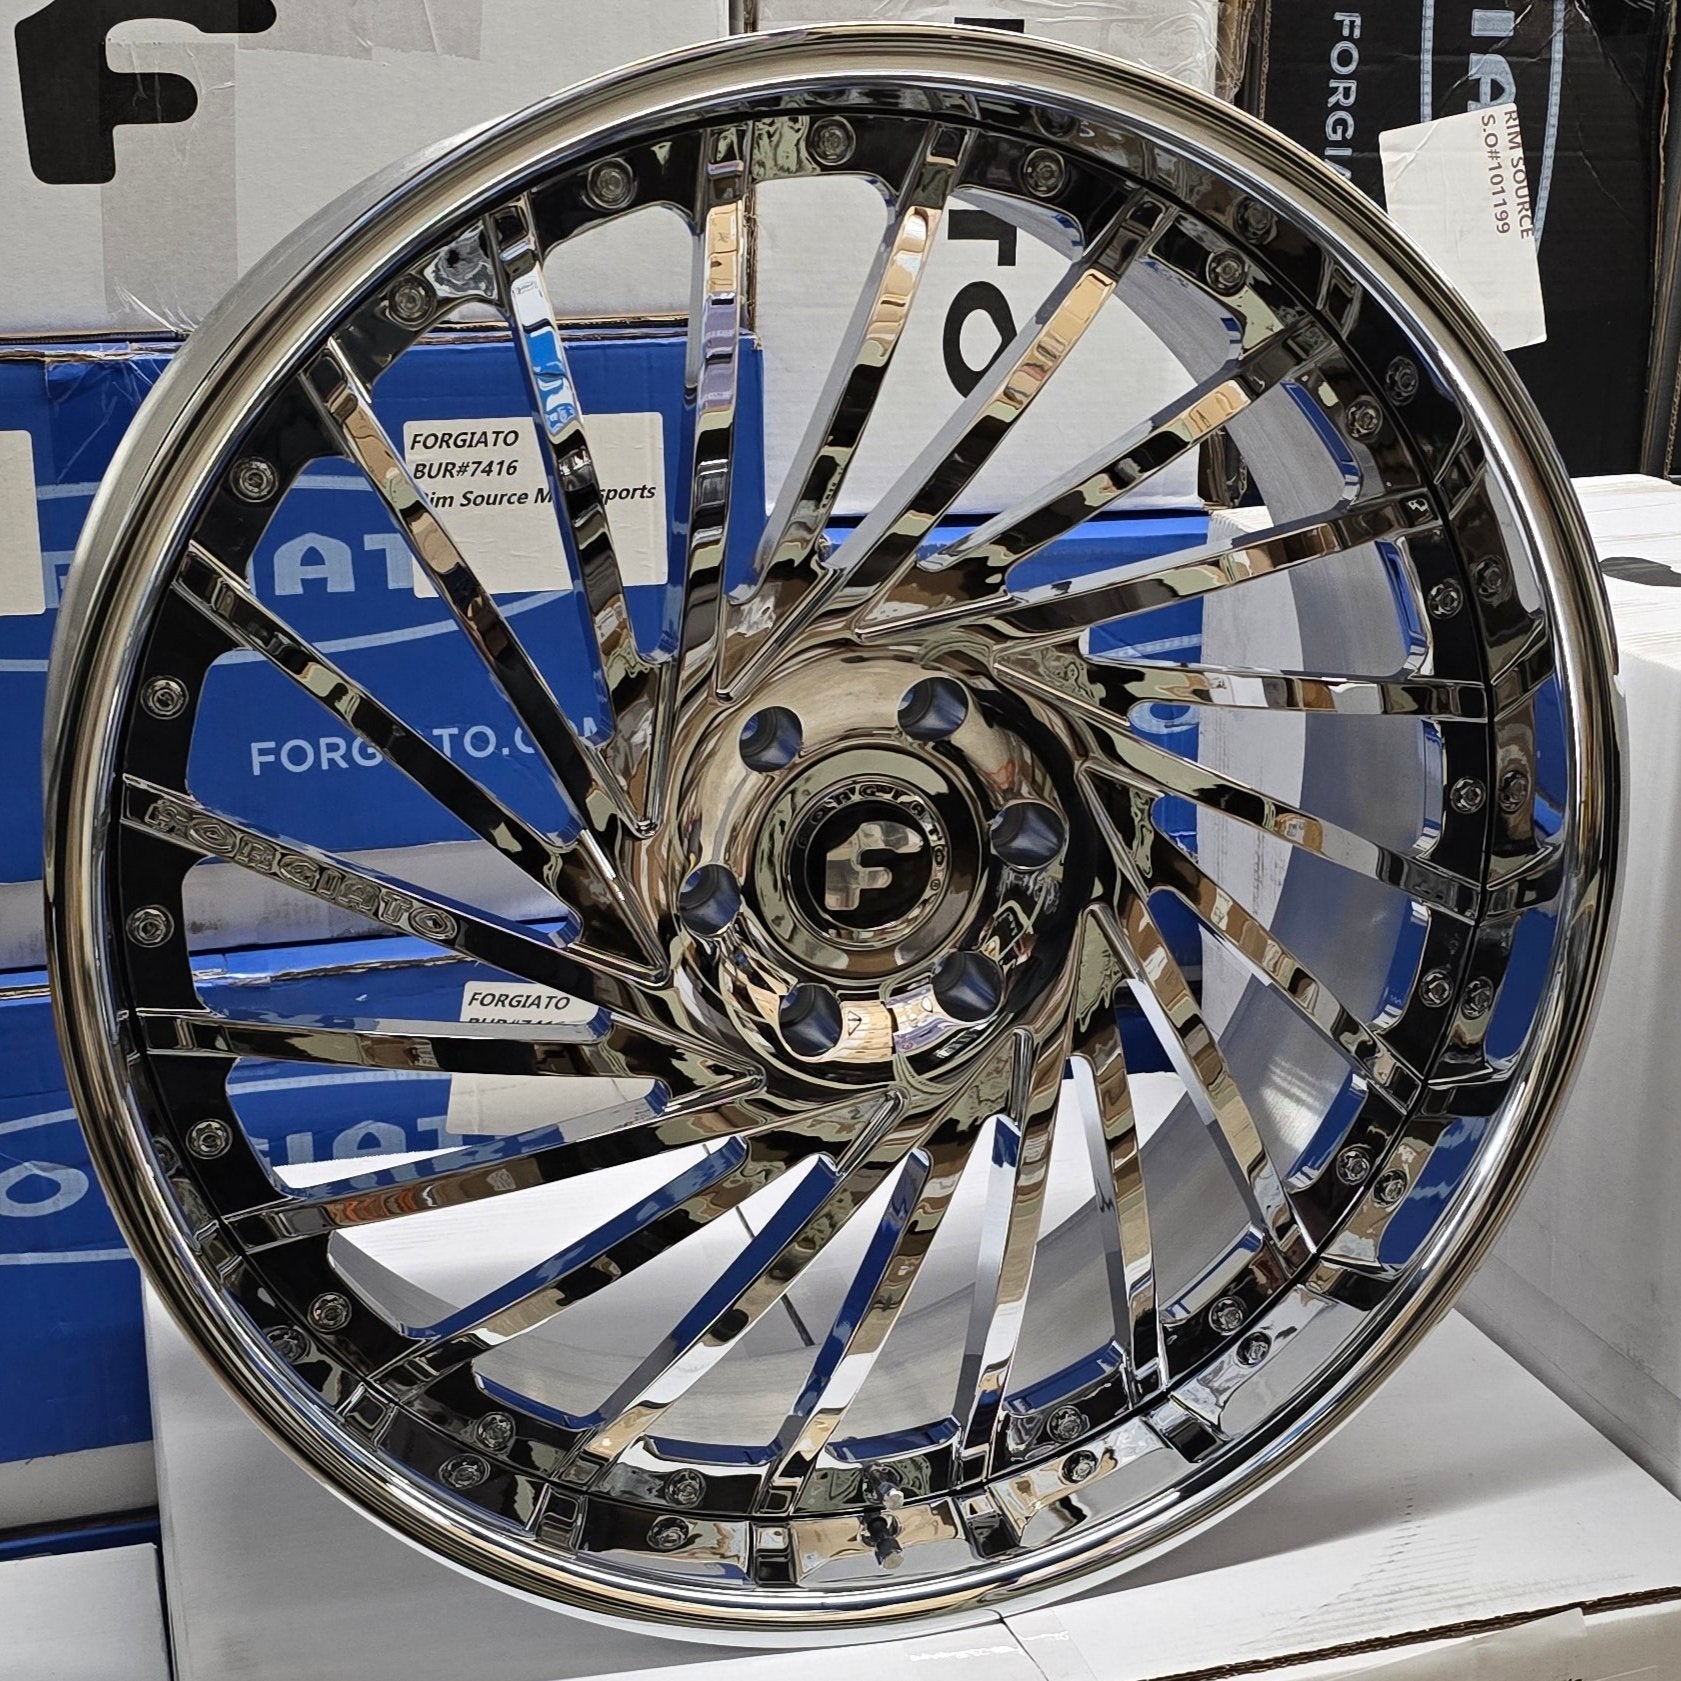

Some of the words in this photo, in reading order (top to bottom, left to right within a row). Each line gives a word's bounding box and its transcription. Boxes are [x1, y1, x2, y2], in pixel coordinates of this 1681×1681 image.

[1504, 109, 1523, 151] RIM
[1481, 113, 1511, 234] S.O#101199
[1511, 156, 1535, 240] SOURCE
[410, 430, 519, 450] FORGIATO
[413, 459, 519, 479] BUR#7416
[460, 489, 528, 507] Source
[534, 484, 656, 505] Msports
[468, 992, 571, 1010] FORGIATO
